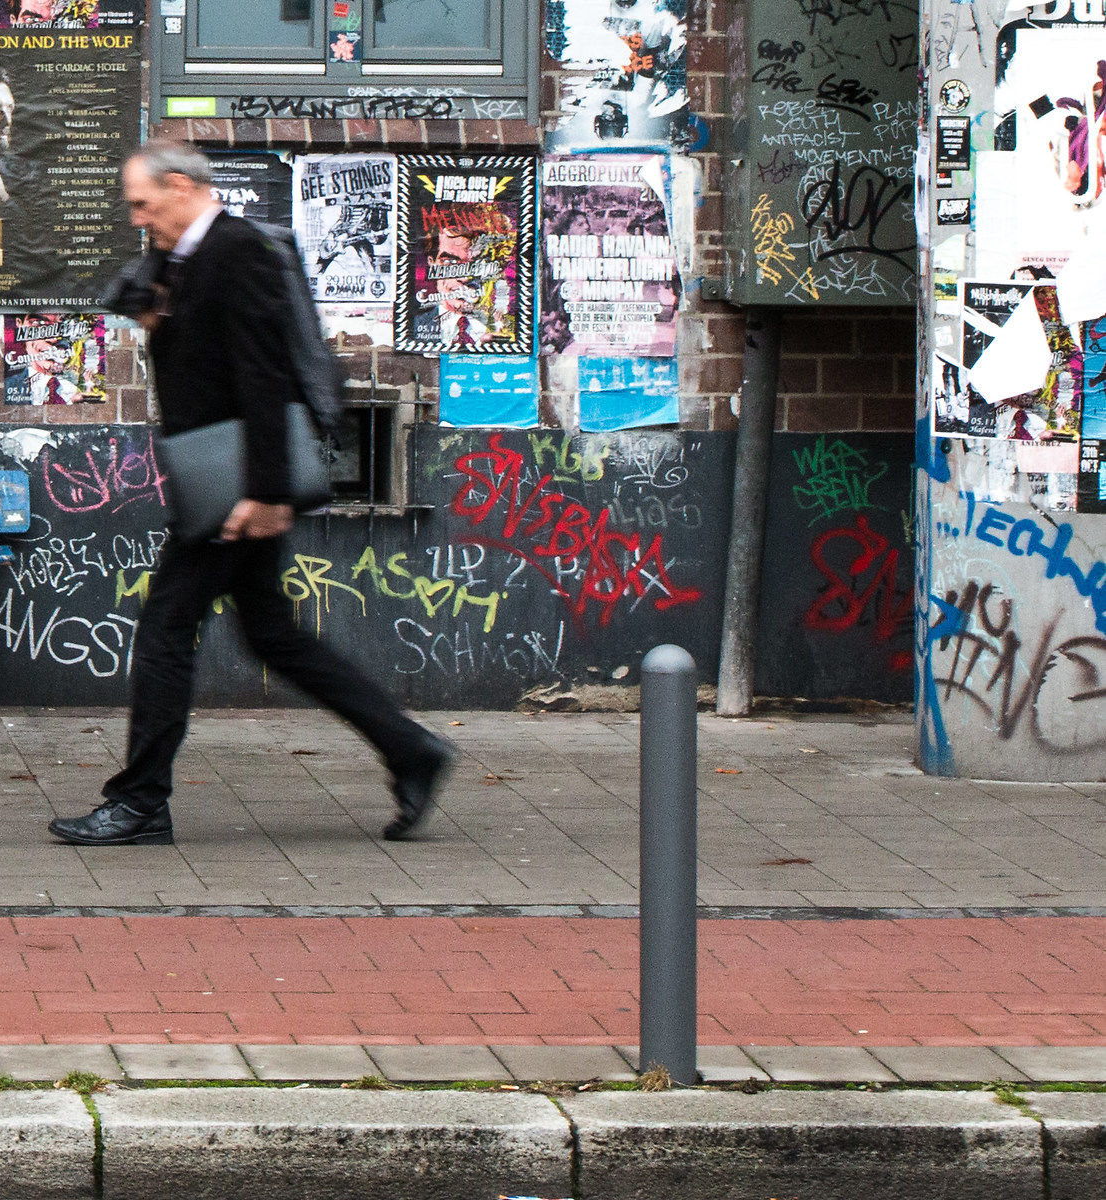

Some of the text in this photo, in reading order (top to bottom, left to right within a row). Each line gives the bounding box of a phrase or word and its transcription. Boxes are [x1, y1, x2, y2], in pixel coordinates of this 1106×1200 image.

[22, 35, 55, 48] AND
[59, 35, 89, 48] THE
[92, 35, 133, 48] WOLF
[96, 63, 128, 71] HOTEL
[307, 163, 320, 174] THE
[547, 164, 643, 182] AGGROPUNK
[301, 161, 391, 200] GEE STRINGS
[547, 235, 672, 257] RADIO HAVANN
[553, 258, 674, 280] FAHNENFLUCHT
